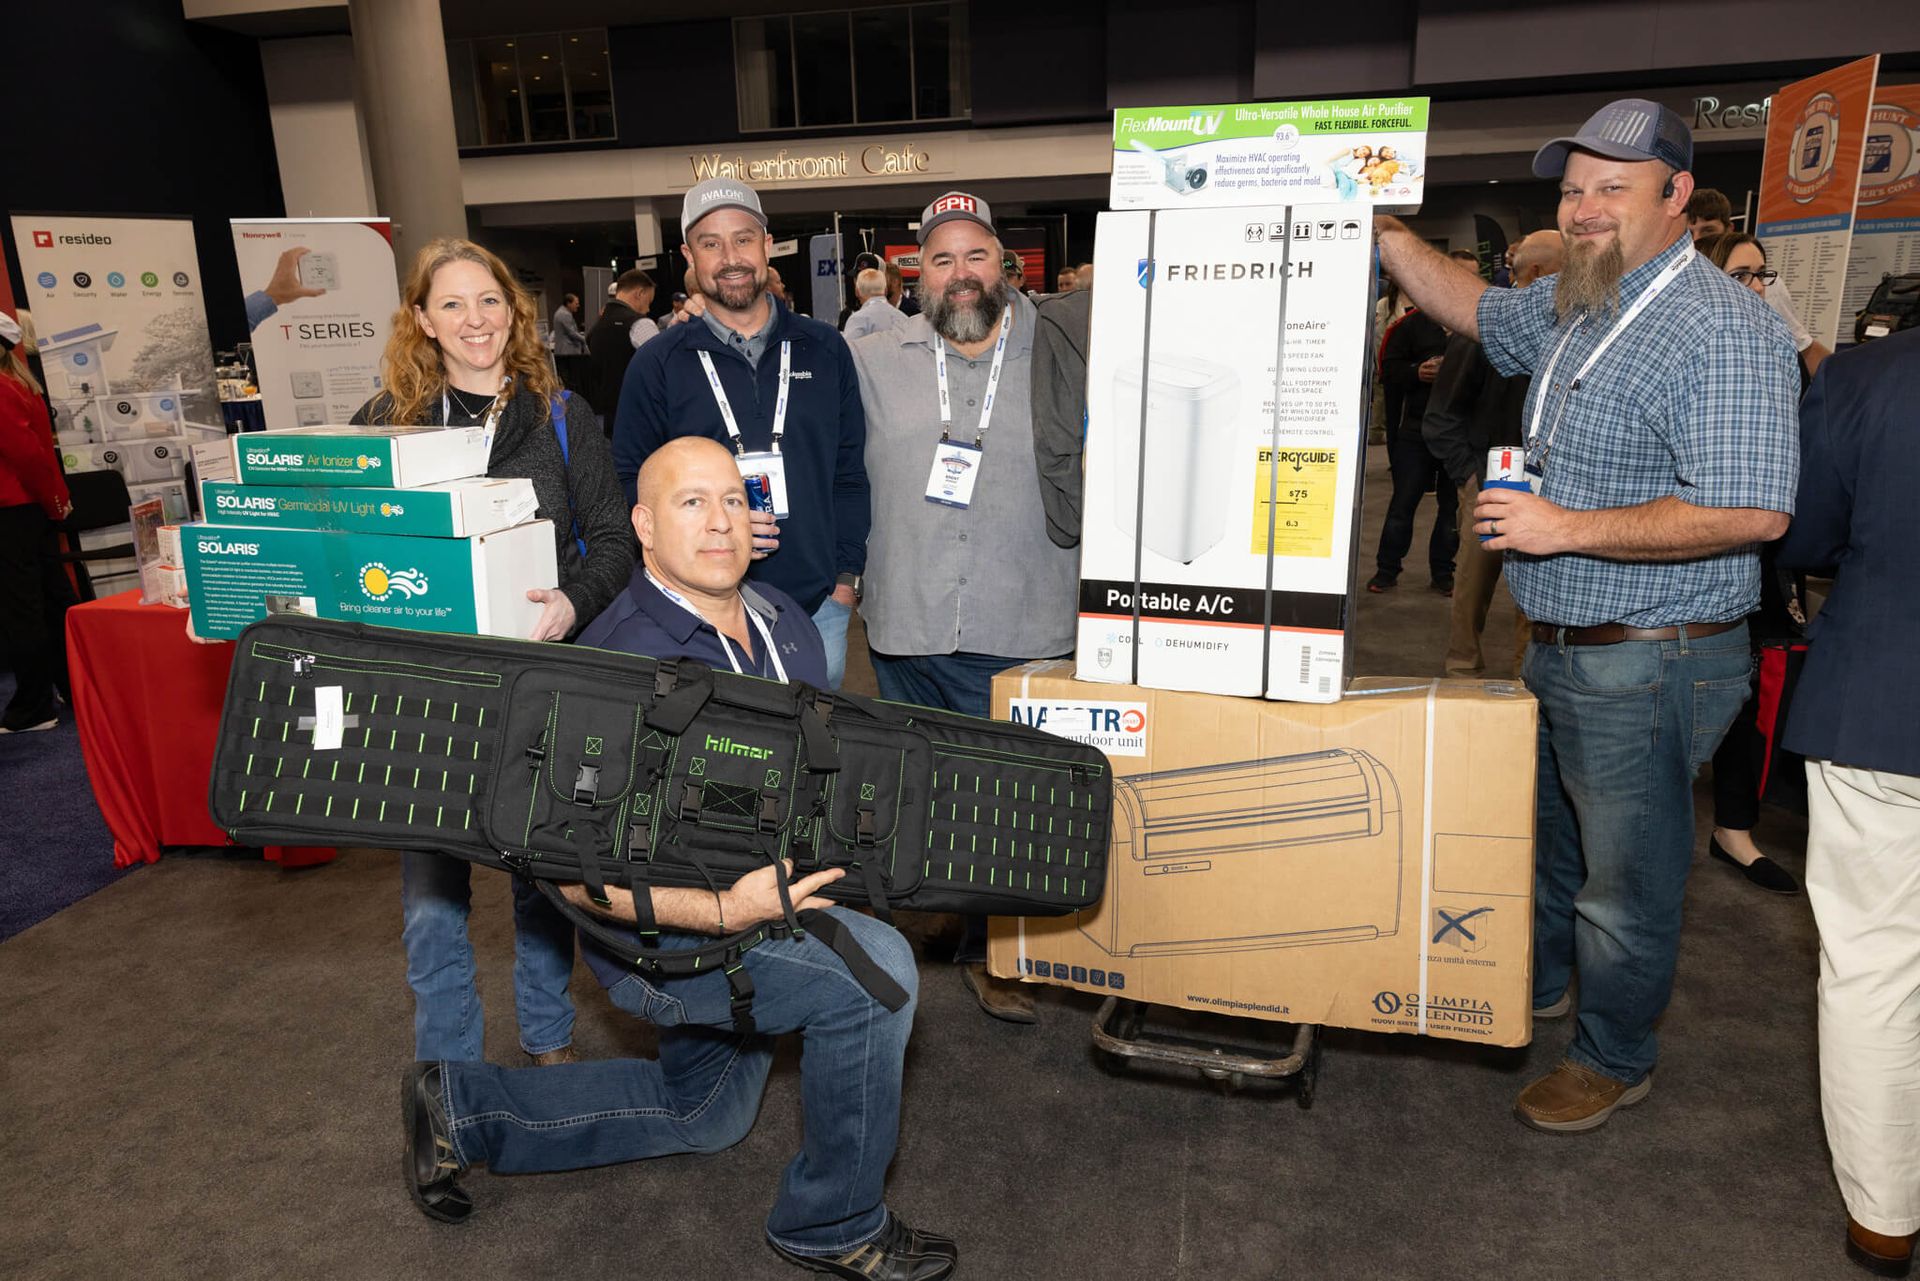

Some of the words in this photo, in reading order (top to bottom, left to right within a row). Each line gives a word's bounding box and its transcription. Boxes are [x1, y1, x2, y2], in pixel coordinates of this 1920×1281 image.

[1235, 106, 1298, 121] Ultra-Versatile
[1301, 105, 1329, 118] Whole
[1332, 104, 1360, 118] House
[1362, 103, 1376, 117] Air
[1378, 101, 1414, 116] Purifier
[1334, 120, 1369, 129] FLEXIBLE.
[1372, 118, 1412, 128] FORCEFUL.
[689, 150, 849, 181] Waterfront
[861, 143, 930, 175] Cafe
[1216, 154, 1247, 163] Maximize
[1248, 153, 1267, 162] HVAC
[1268, 152, 1301, 163] operating
[1215, 165, 1255, 175] effectiveness
[1257, 166, 1269, 174] and
[1271, 164, 1310, 176] significantly
[1215, 178, 1236, 188] reduce
[1289, 176, 1302, 186] and
[934, 197, 974, 214] EPH
[58, 232, 112, 246] resideo
[242, 232, 282, 240] Honeywell
[1167, 261, 1313, 281] FRIEDRICH
[280, 324, 292, 340] T
[299, 321, 375, 340] SERIES
[1283, 320, 1330, 330] oneAire
[1311, 351, 1324, 359] FAN
[307, 454, 319, 466] Air
[322, 454, 354, 467] Ionizer
[1288, 489, 1308, 499] $75
[278, 497, 330, 513] Germicidal
[332, 500, 348, 514] UV
[350, 500, 376, 516] Light
[1107, 588, 1191, 612] Portable
[1196, 595, 1234, 615] A/C
[340, 602, 361, 614] Bring
[362, 603, 391, 614] cleaner
[393, 604, 404, 614] air
[405, 605, 414, 615] to
[415, 607, 433, 617] your
[1118, 635, 1144, 645] COL
[1165, 638, 1231, 652] DEHUMIDIFY
[1117, 735, 1143, 748] unit
[1418, 953, 1442, 963] Snza
[1466, 958, 1496, 967] esterna
[1187, 994, 1290, 1015] www.olimpiasplendid.it
[1406, 993, 1492, 1011] OIMPIA
[1405, 1007, 1493, 1026] SLENDID
[1397, 1020, 1428, 1028] SISTEI
[1430, 1023, 1451, 1031] USER
[1453, 1025, 1493, 1035] FRIENDLY
